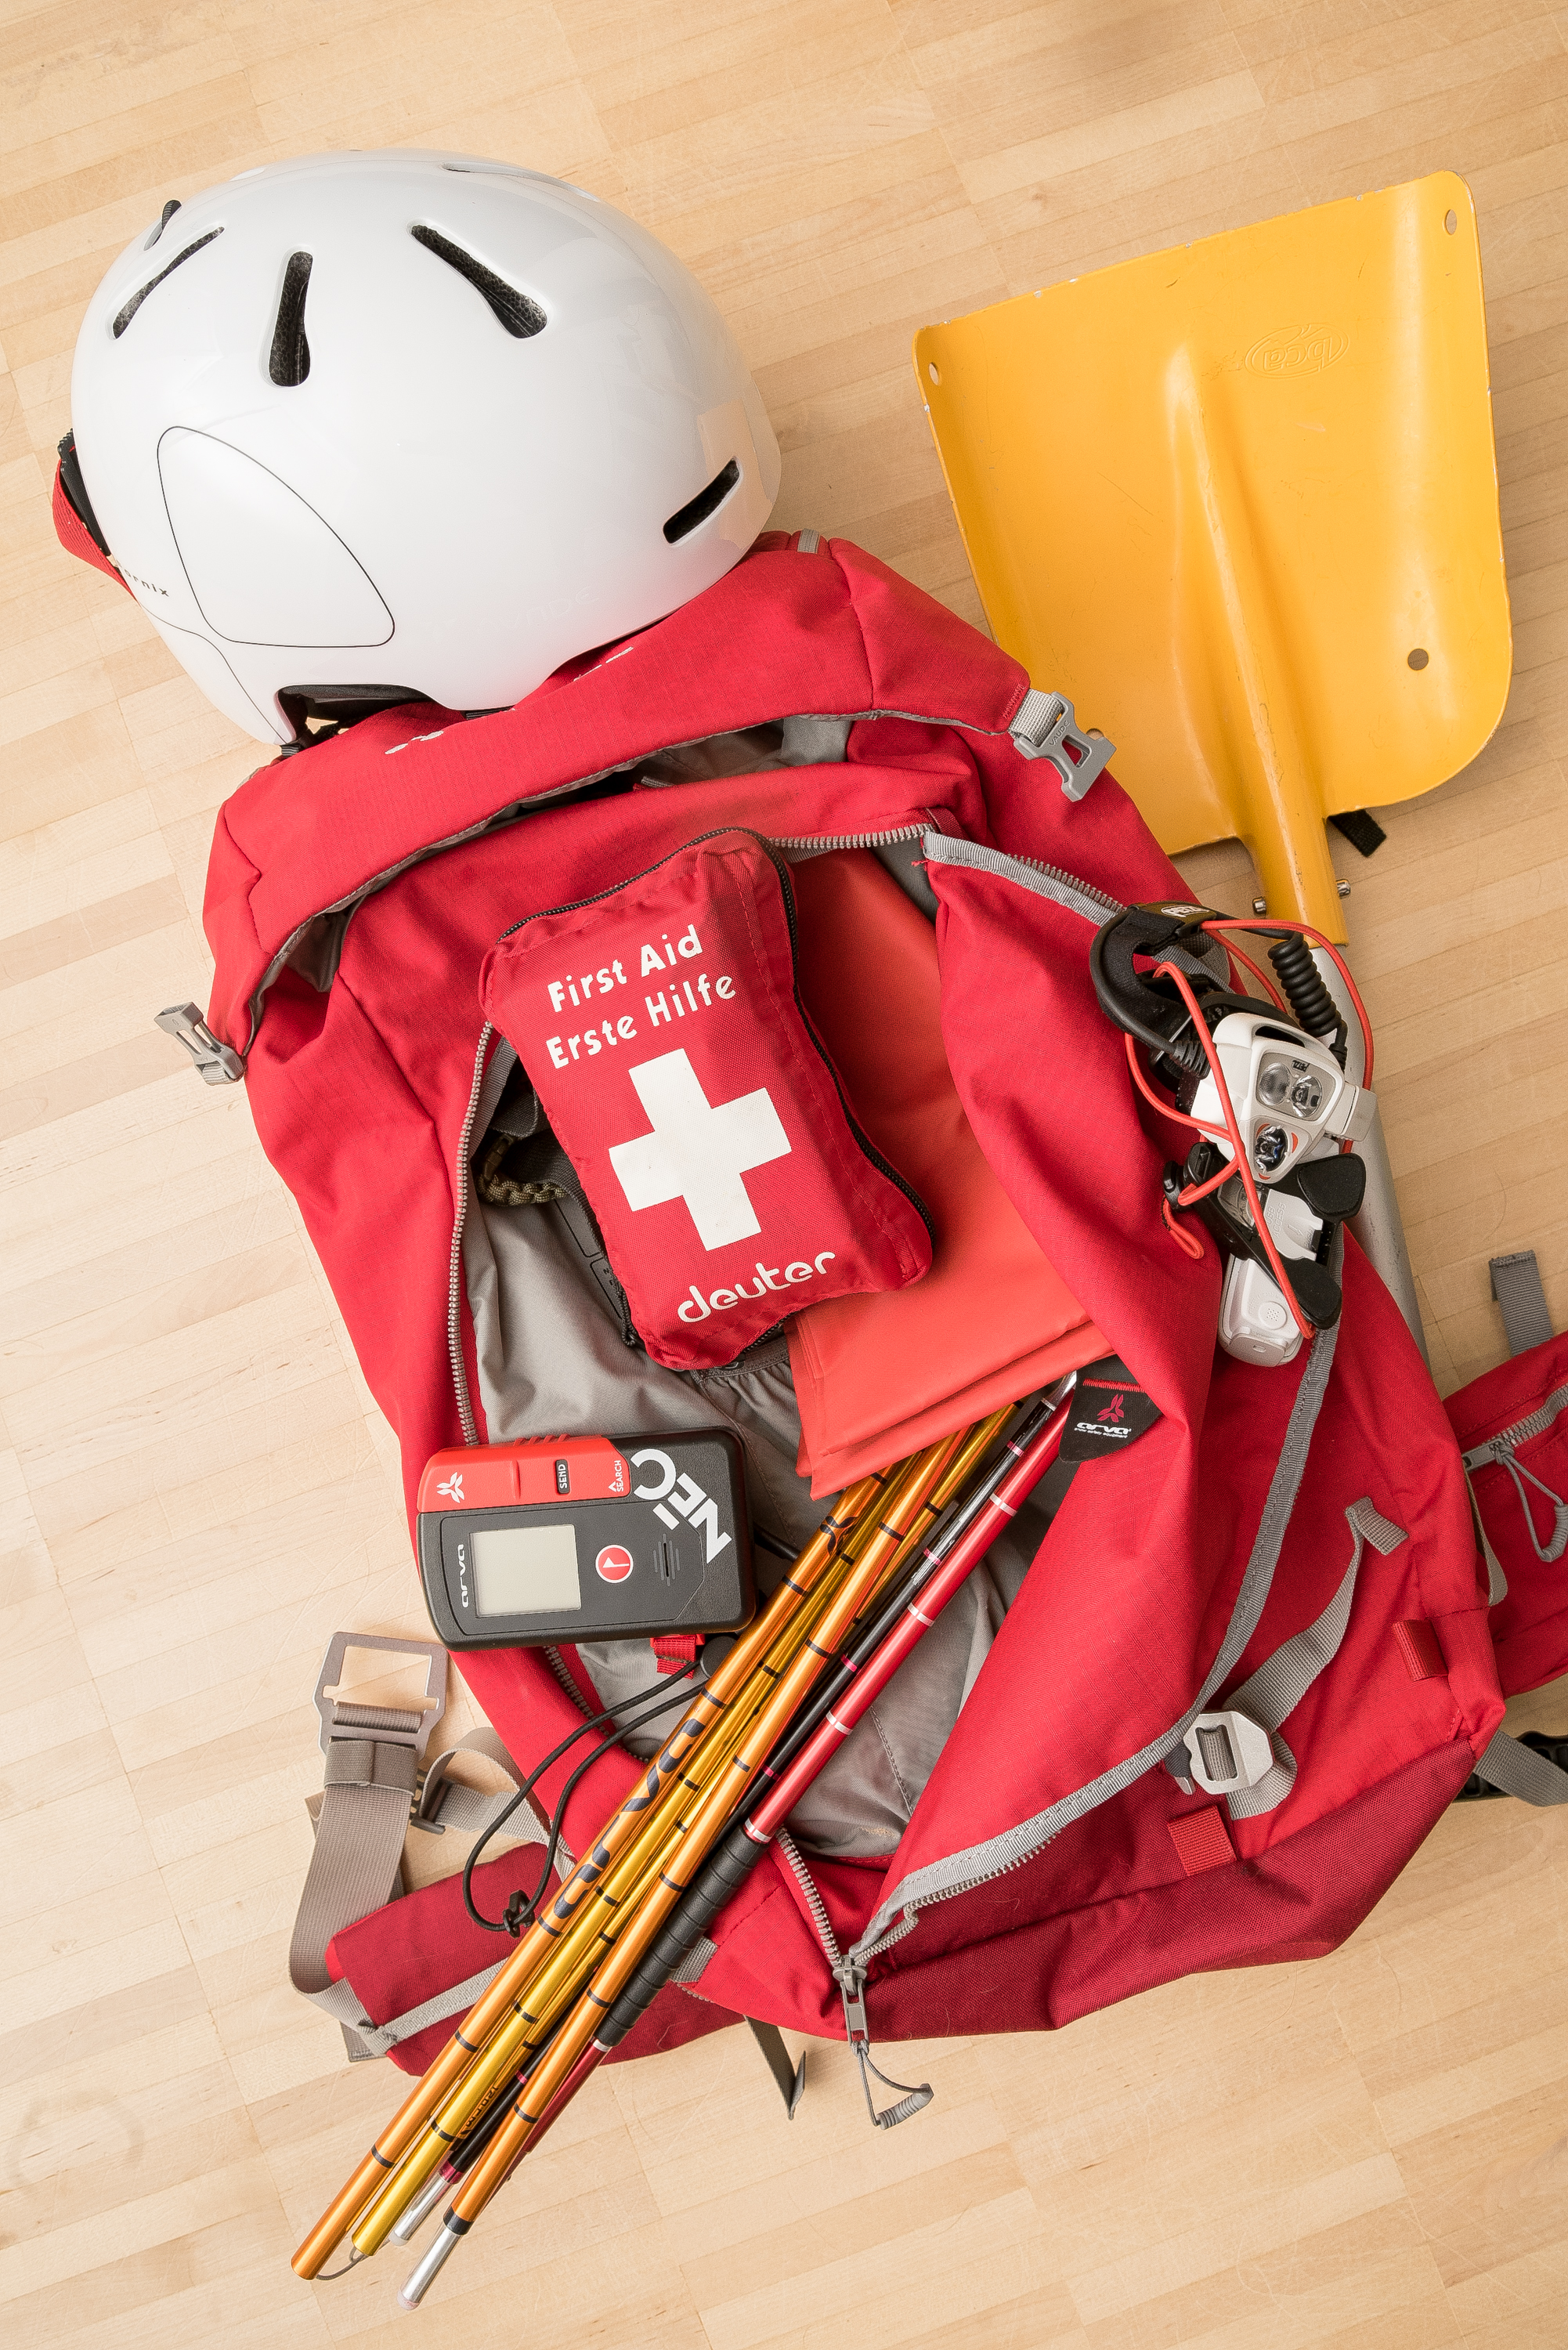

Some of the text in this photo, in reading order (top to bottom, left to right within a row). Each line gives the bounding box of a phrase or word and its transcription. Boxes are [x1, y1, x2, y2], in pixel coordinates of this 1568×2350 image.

[116, 559, 170, 598] ornix
[1049, 719, 1071, 747] VAUDE
[547, 924, 703, 1013] First Aid
[546, 973, 736, 1069] Erste Hilfe
[1292, 1060, 1310, 1073] PETZL
[1266, 1206, 1276, 1224] USB
[1273, 1202, 1287, 1238] ACCESS
[677, 1251, 836, 1322] deuter
[1076, 1422, 1129, 1435] arva
[558, 1463, 568, 1489] SEND
[614, 1460, 624, 1492] SEARCH
[457, 1544, 469, 1608] arva
[553, 1718, 706, 1920] arva
